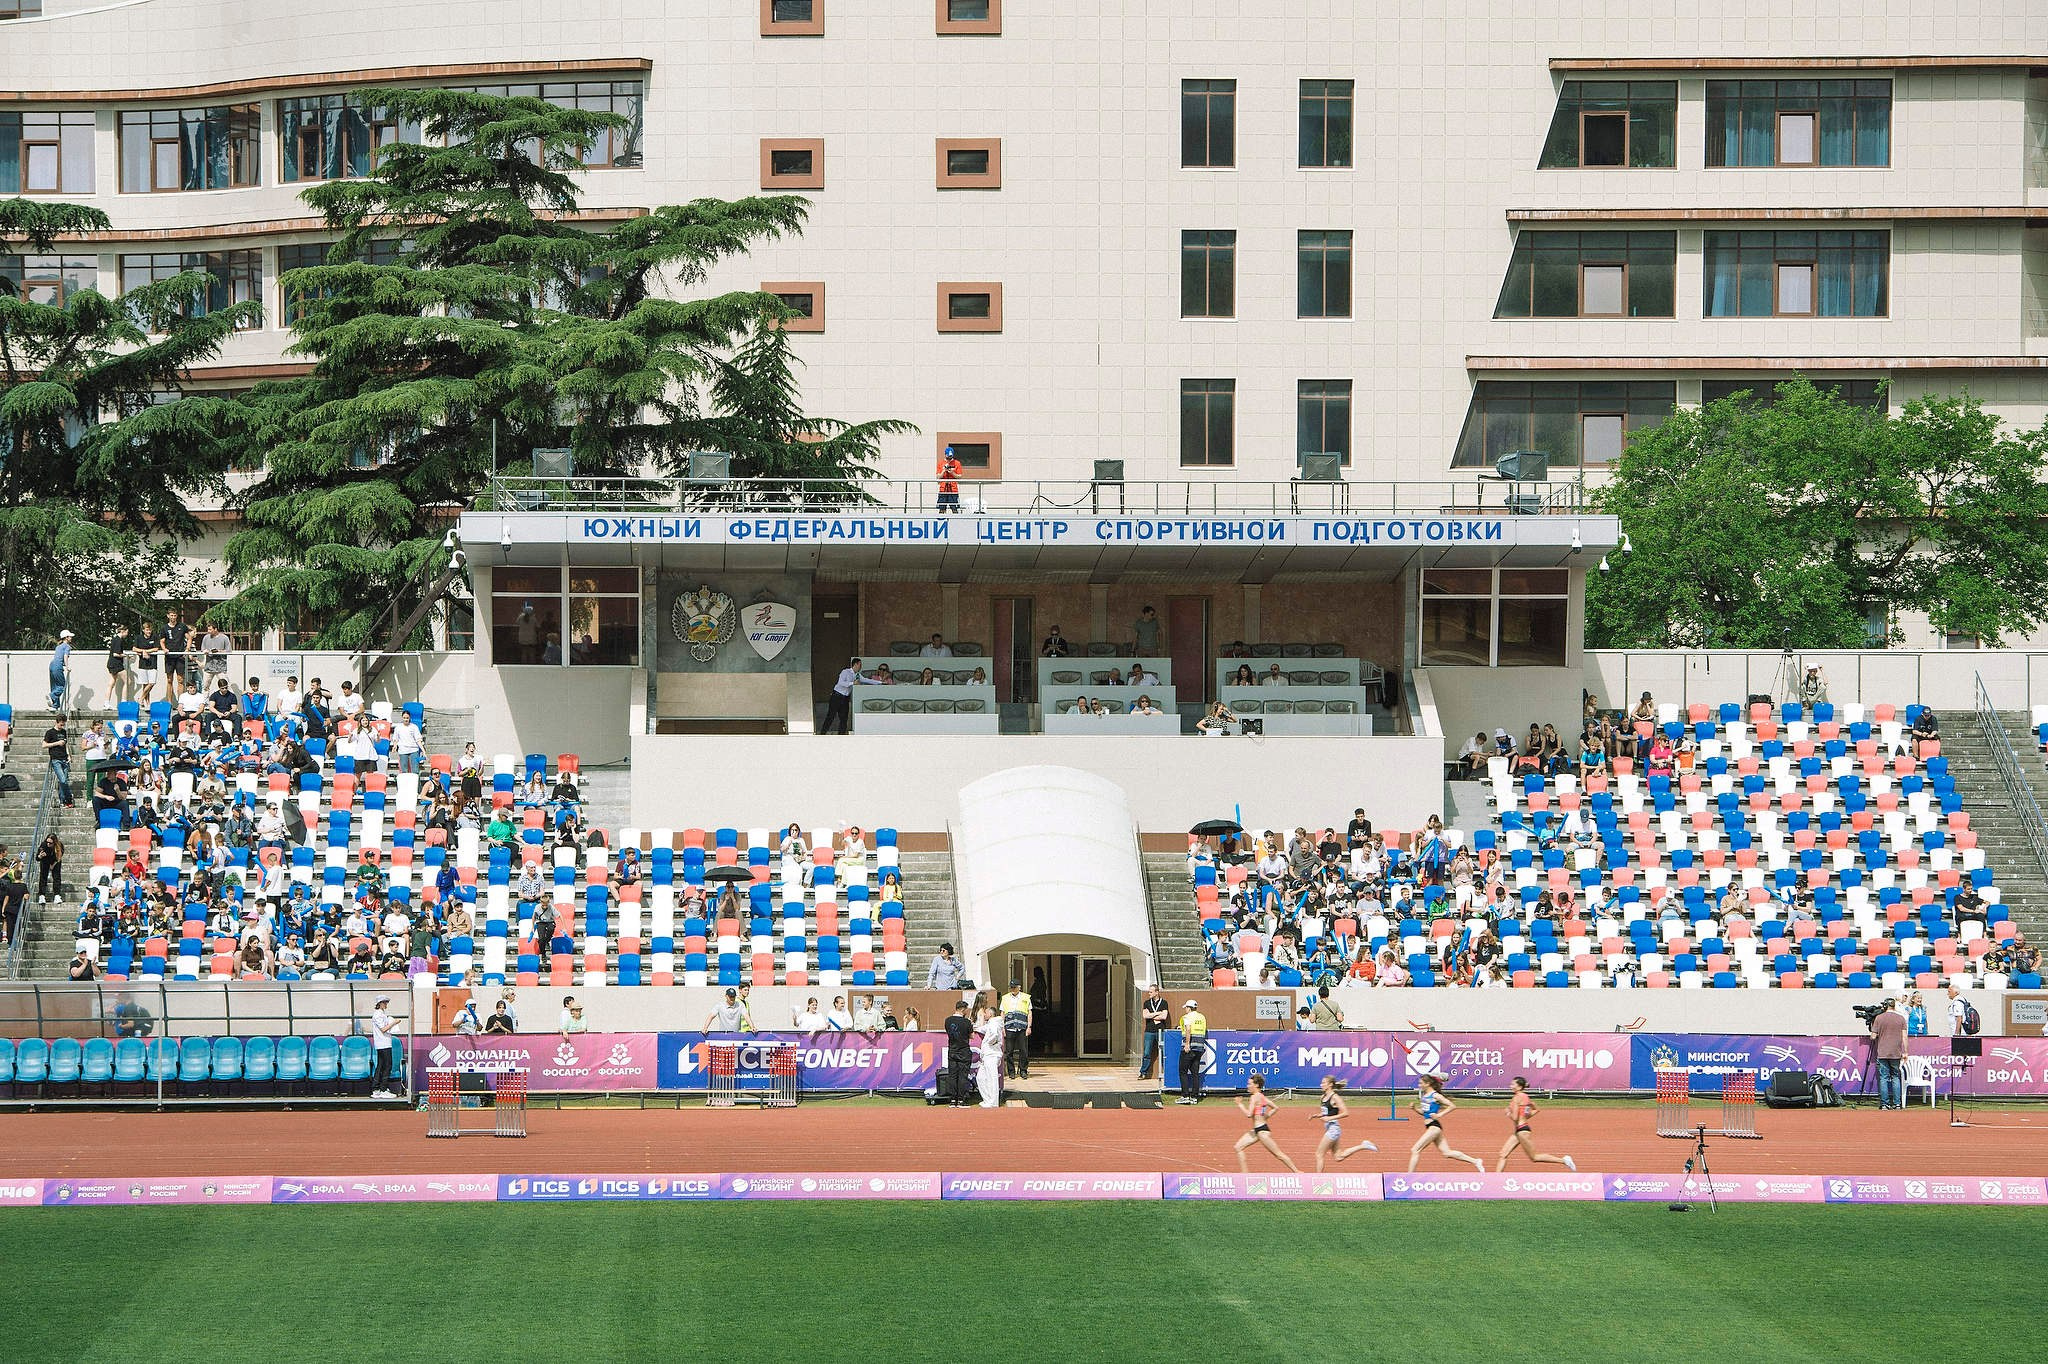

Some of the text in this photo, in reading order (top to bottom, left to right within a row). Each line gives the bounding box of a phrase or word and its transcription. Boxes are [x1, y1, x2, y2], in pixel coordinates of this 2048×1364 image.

[584, 516, 1502, 544] ЮЖНЫЙ ФЕДЕРАЛЬНЫЙ ЦЕНТР СПОРТИВНОЙ ПОДГОТОВКИ
[750, 632, 764, 641] ЮГ
[455, 1050, 530, 1060] КОМАНДА
[795, 1048, 889, 1068] FONBET
[1687, 1053, 1750, 1063] МИНСПОРТ
[542, 1068, 589, 1077] ФОСАГРО
[598, 1067, 641, 1076] ФОСАГРО
[1227, 1067, 1280, 1075] GROUP
[1987, 1069, 2033, 1083] ВФЛА
[532, 1181, 570, 1193] ПСБ
[602, 1181, 640, 1192] ПСБ
[672, 1180, 709, 1192] ПСБ
[950, 1180, 1154, 1191] FONBET FONBET FONBET
[1203, 1177, 1236, 1188] URAL
[1270, 1177, 1303, 1188] URAL
[1336, 1177, 1368, 1188] URAL
[1411, 1182, 1482, 1192] ФОСАГРО
[1523, 1182, 1593, 1192] ФОСАГРО
[312, 1186, 344, 1194] ВФЛА
[384, 1185, 417, 1193] ВФЛА
[458, 1184, 490, 1192] ВФЛА
